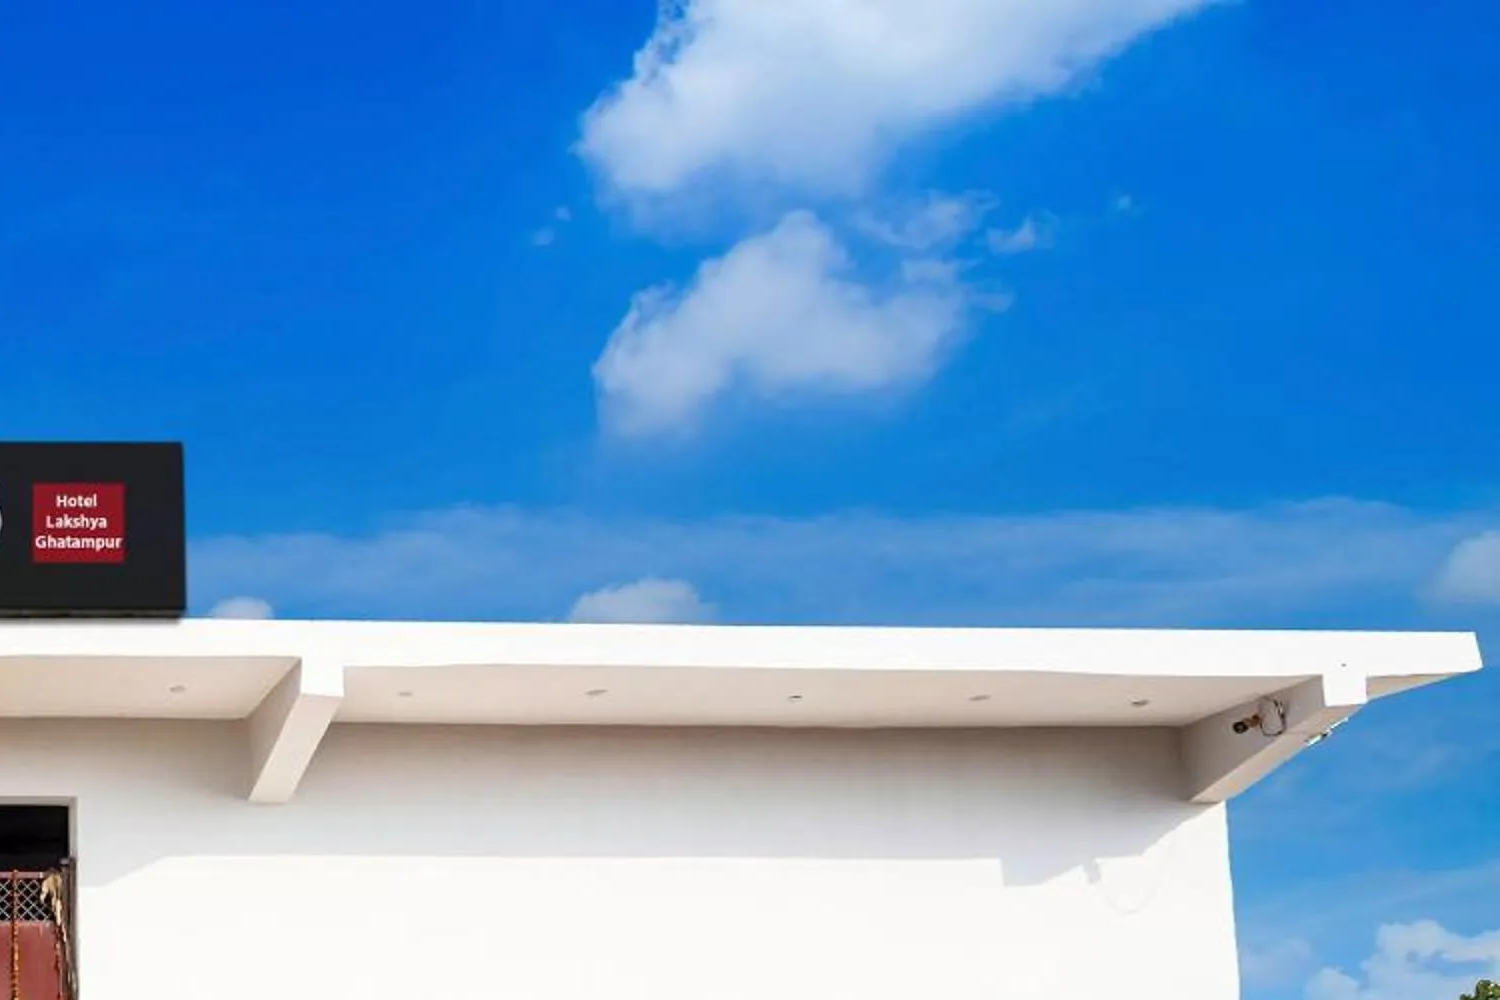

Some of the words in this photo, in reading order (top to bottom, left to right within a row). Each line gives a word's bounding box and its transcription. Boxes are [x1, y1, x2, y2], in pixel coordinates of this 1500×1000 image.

[56, 493, 98, 508] Hotel
[45, 514, 108, 530] Lakshya
[35, 535, 123, 551] Ghatampur
